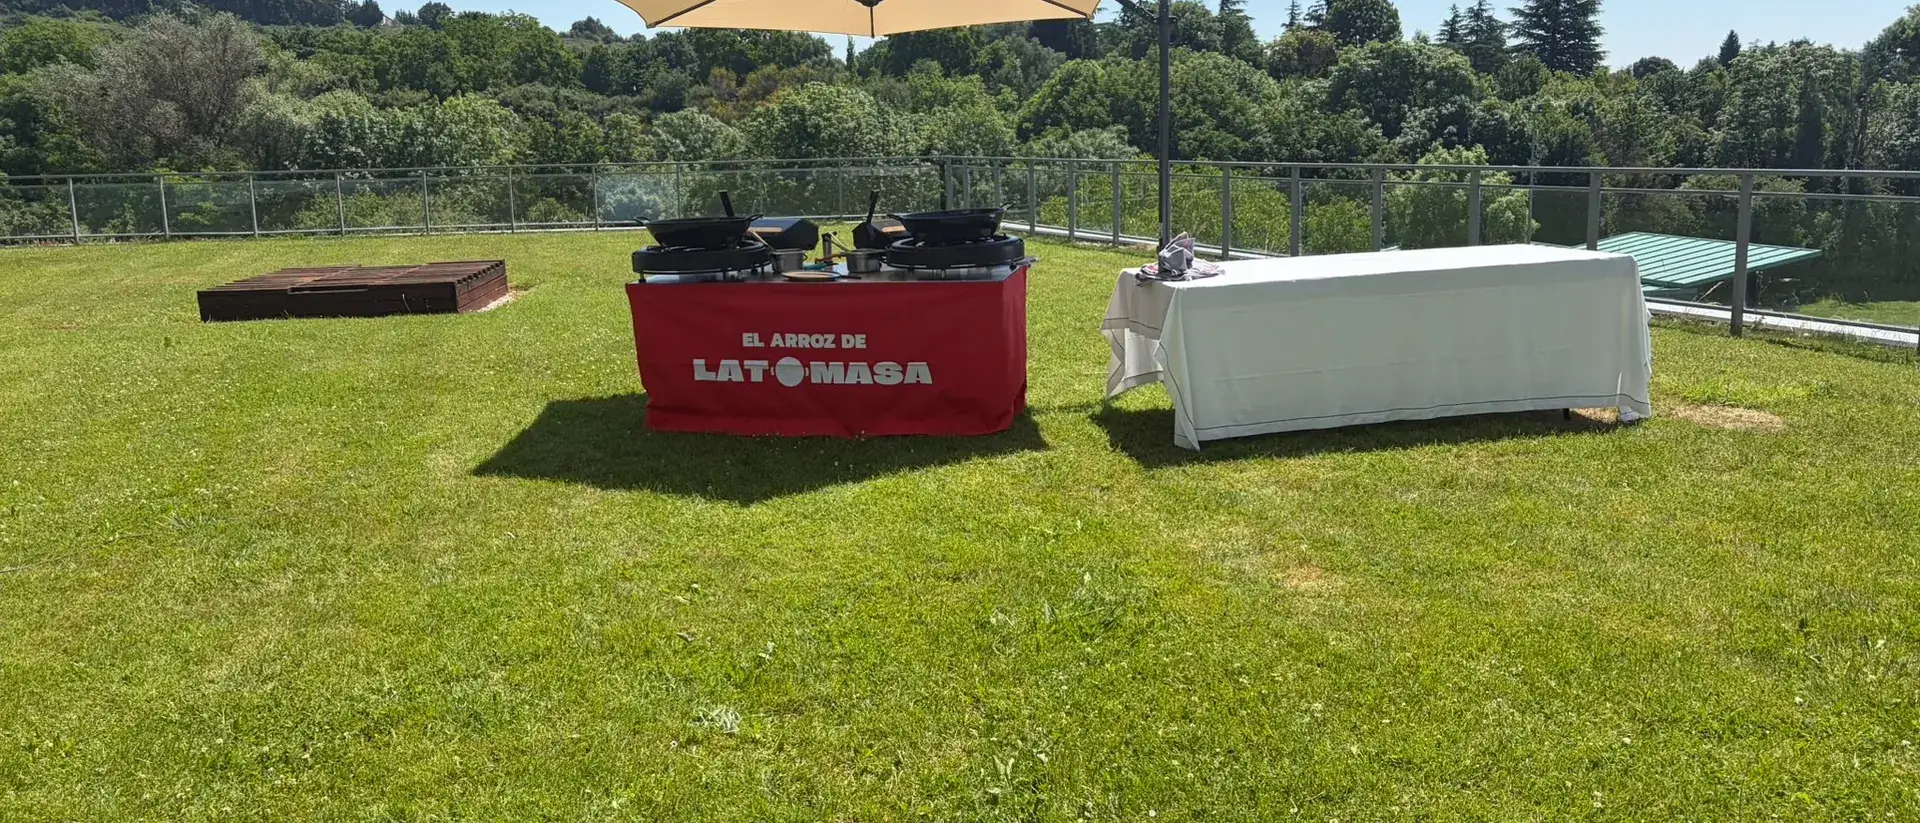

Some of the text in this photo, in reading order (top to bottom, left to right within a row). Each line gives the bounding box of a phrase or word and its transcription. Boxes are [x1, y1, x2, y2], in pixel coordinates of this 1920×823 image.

[742, 332, 867, 349] EL ARROZ DE
